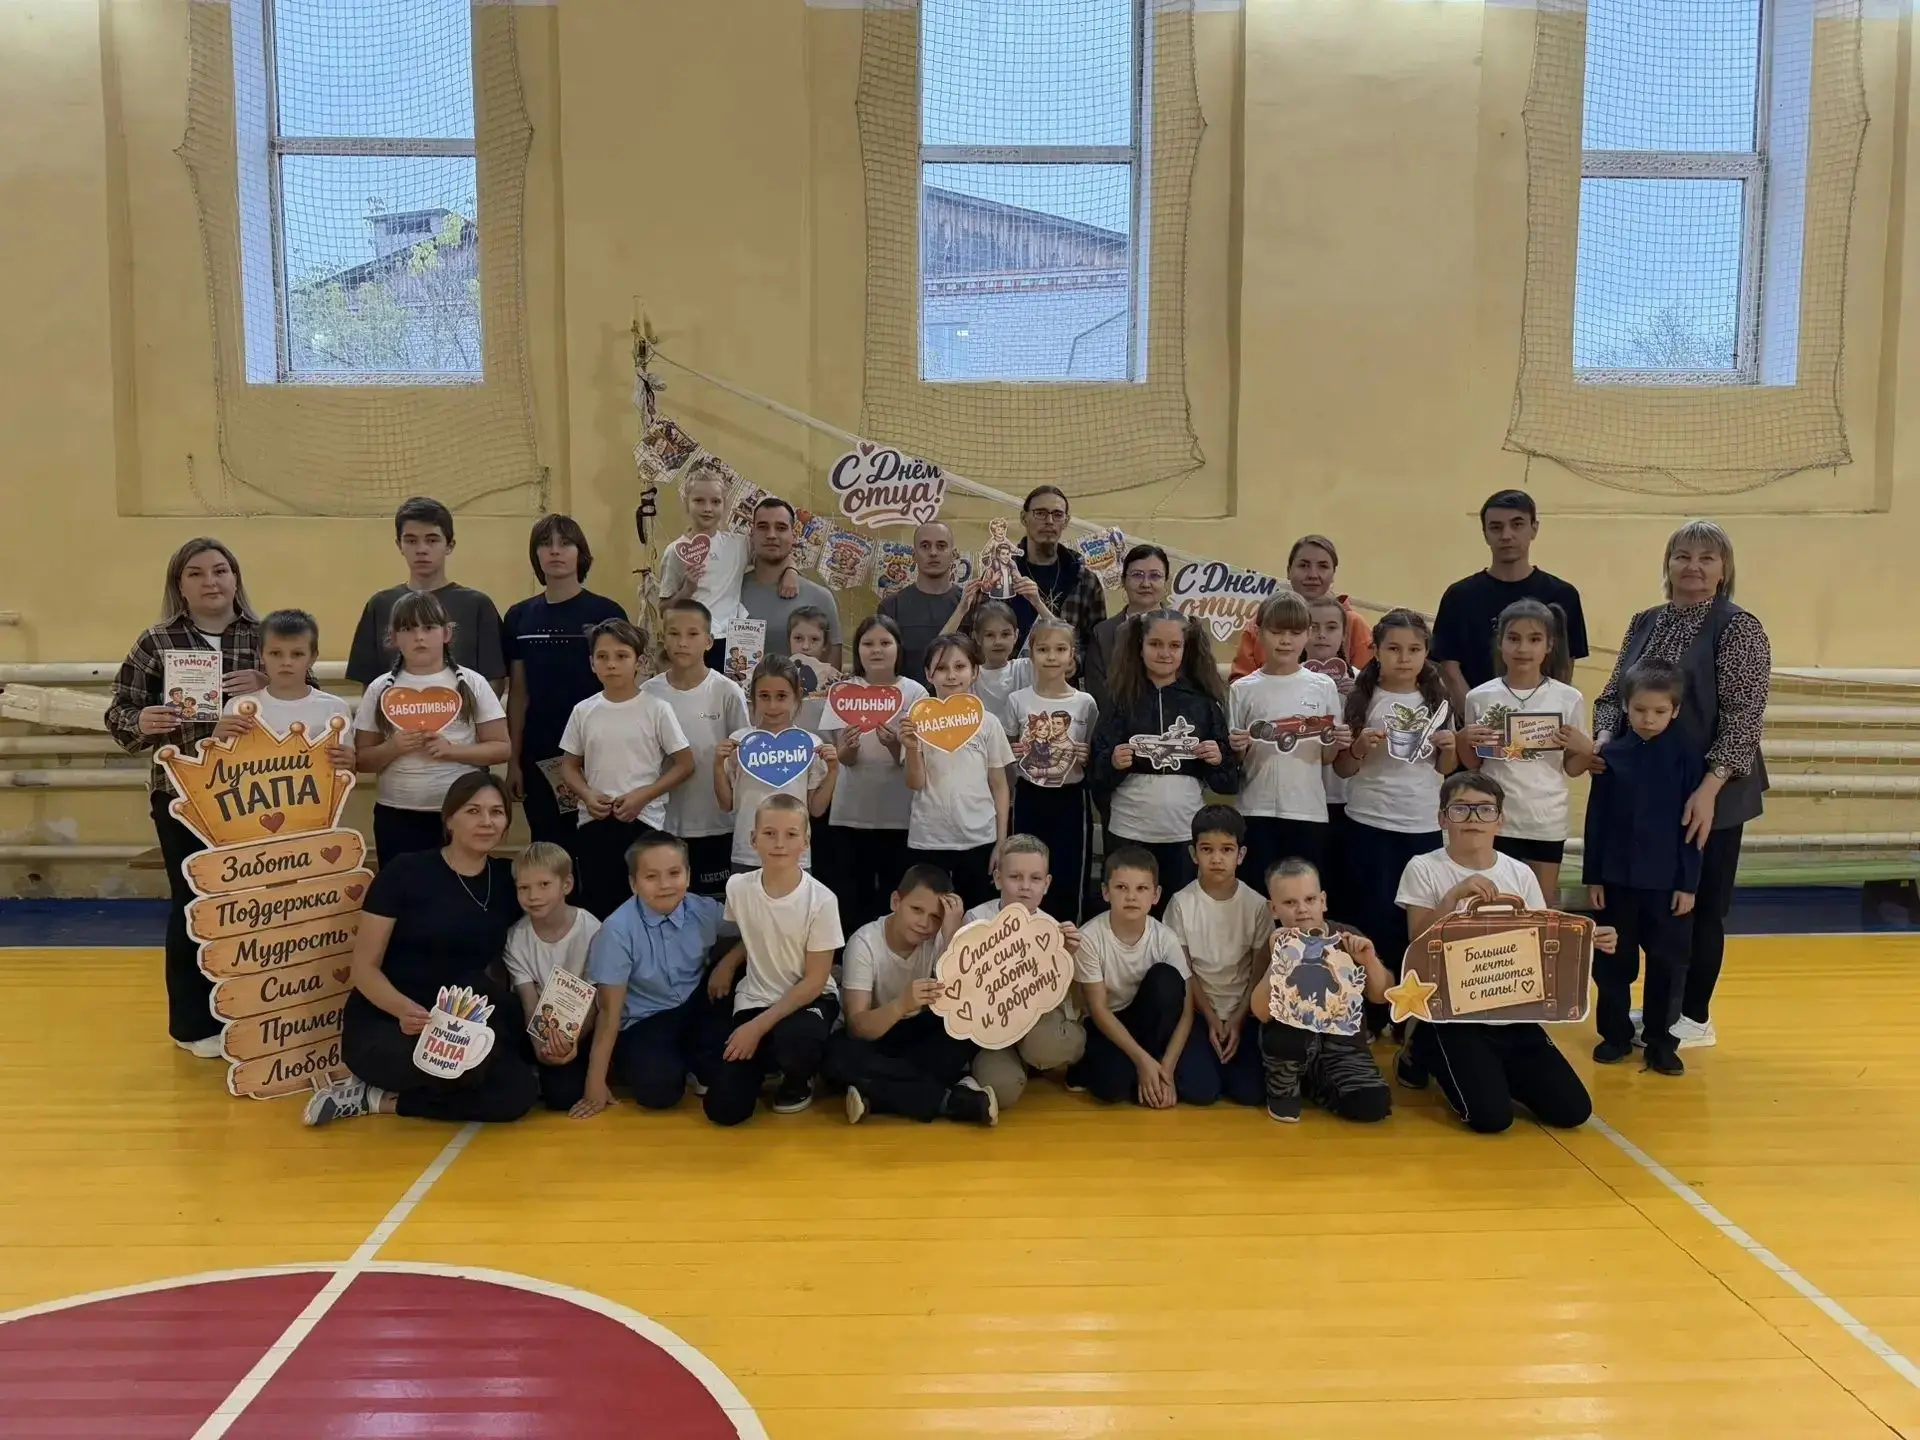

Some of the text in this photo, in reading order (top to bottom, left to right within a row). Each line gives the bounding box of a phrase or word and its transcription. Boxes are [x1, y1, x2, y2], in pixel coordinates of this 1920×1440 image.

[832, 450, 941, 490] С Днём
[843, 479, 944, 516] отца!
[1173, 562, 1279, 596] С Днём
[734, 624, 761, 633] ГРАМОТА
[173, 658, 212, 668] ГРАМОТА
[388, 700, 456, 716] ЗАБОТЛИВЫЙ
[837, 695, 897, 712] СИЛЬНЫЙ
[915, 708, 979, 733] НАДЕЖНЫЙ
[205, 750, 313, 790] Лучший
[748, 746, 807, 768] ДОБРЫЙ
[214, 774, 320, 821] ПАПА
[221, 851, 312, 883] Забота
[216, 888, 341, 927] Поддержка
[231, 926, 348, 967] Мудрость
[959, 914, 1021, 975] Спасибо
[1464, 943, 1518, 963] Большие
[974, 937, 1031, 989] за силу,
[1460, 967, 1535, 989] начинаются
[1472, 959, 1515, 974] мечты
[260, 972, 323, 1002] Сила
[557, 978, 587, 1000] ГРАМОТА
[981, 954, 1062, 1029] и доброту!
[985, 956, 1039, 1006] заботу
[1469, 979, 1517, 1000] с папы!
[424, 1035, 466, 1062] ПАПА
[429, 1056, 459, 1071] мире!
[262, 1042, 340, 1086] Любов
